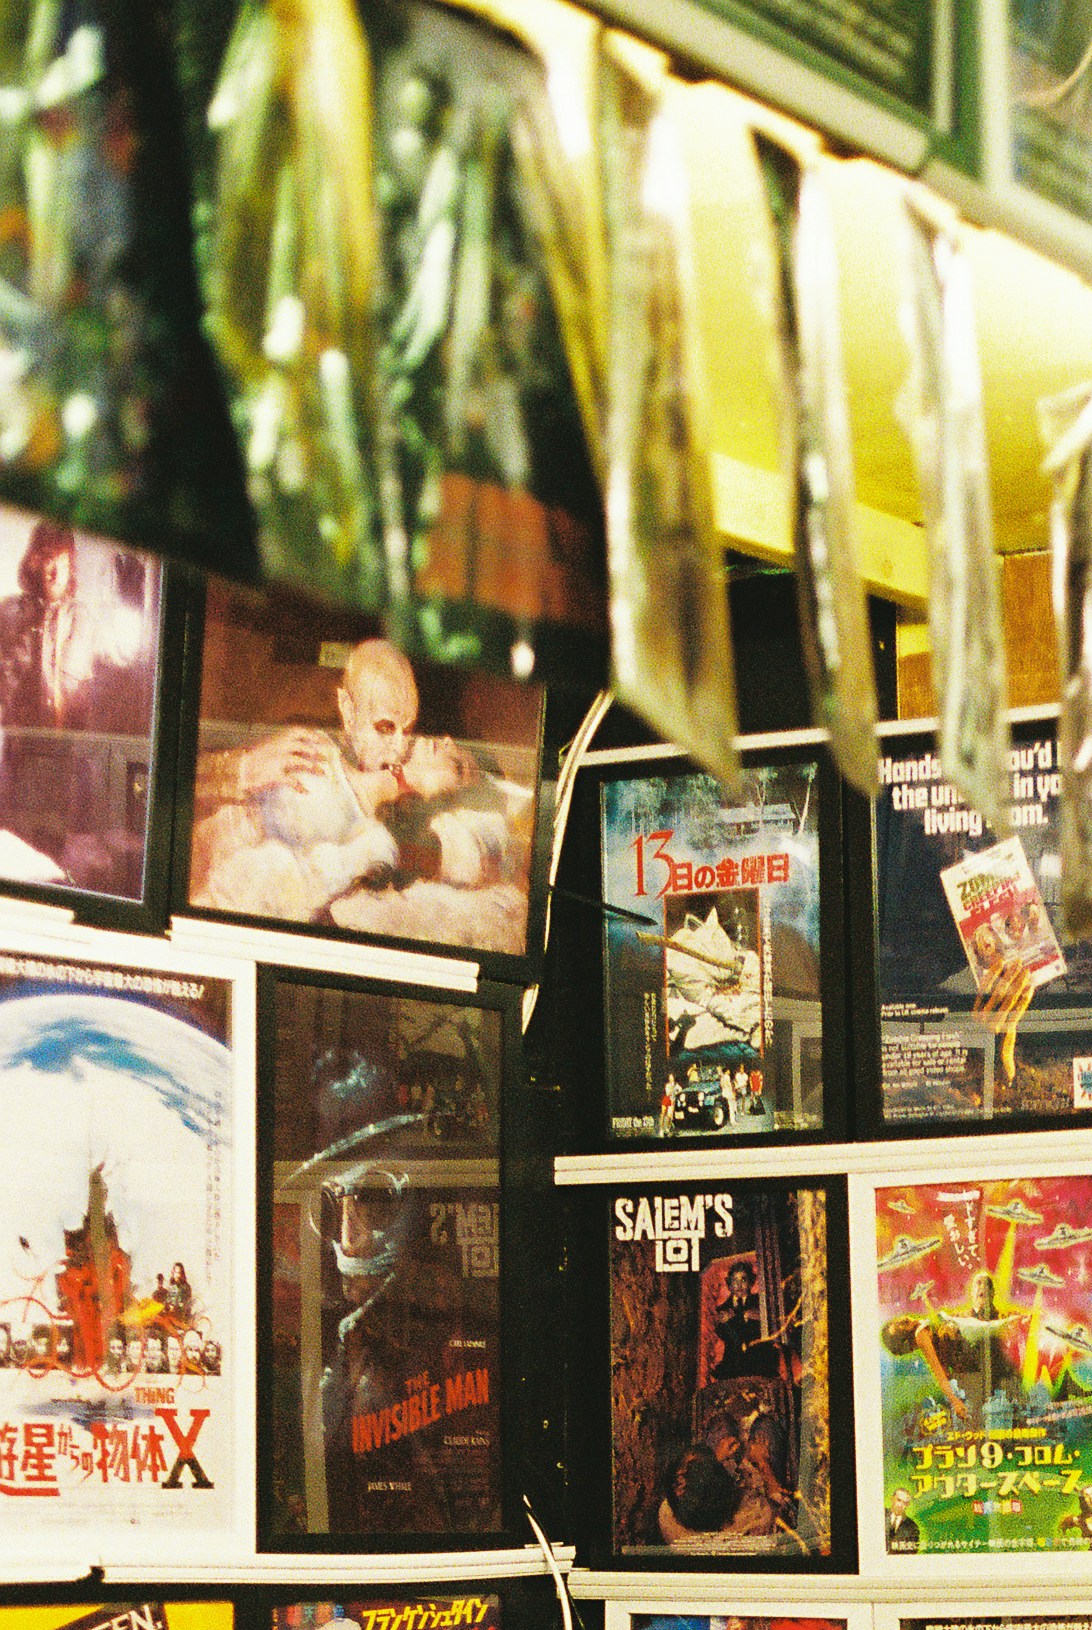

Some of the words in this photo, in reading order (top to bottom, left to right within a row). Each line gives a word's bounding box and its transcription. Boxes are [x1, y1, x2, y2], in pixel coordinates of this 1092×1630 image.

[891, 784, 928, 811] the
[1013, 773, 1034, 799] in
[924, 806, 983, 837] living
[630, 829, 790, 899] 13日の金曜日
[615, 1193, 734, 1241] SALEM'S
[655, 1238, 700, 1272] LOT
[135, 1386, 175, 1405] THING
[352, 1383, 441, 1454] INVISIBLE
[446, 1367, 490, 1414] MAN
[911, 1469, 1083, 1499] アウタースペース
